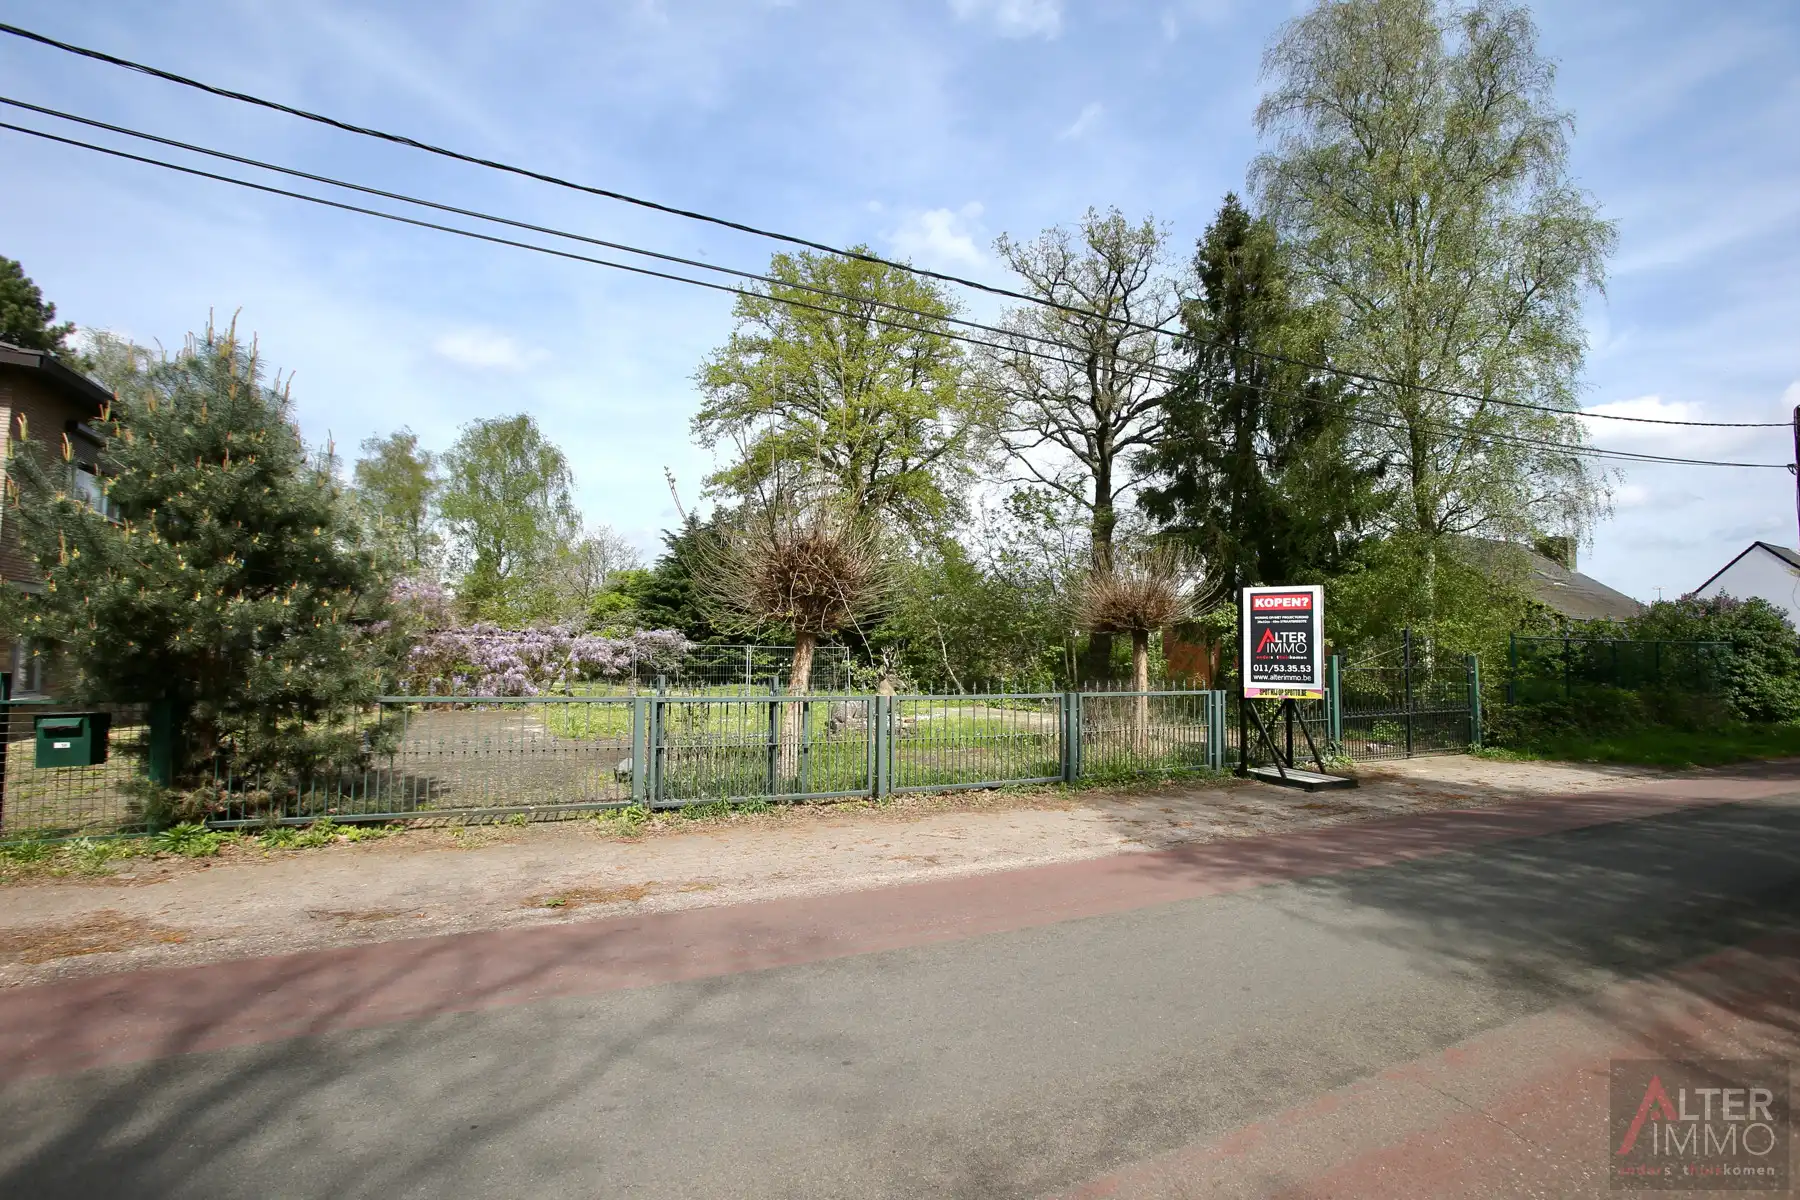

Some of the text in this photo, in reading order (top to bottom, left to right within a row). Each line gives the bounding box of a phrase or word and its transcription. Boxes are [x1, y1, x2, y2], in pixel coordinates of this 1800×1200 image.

[1254, 597, 1309, 608] KOPEN?
[1256, 627, 1307, 653] ALTER
[1266, 642, 1307, 654] IMMO
[1253, 664, 1311, 673] 011/53.35.53
